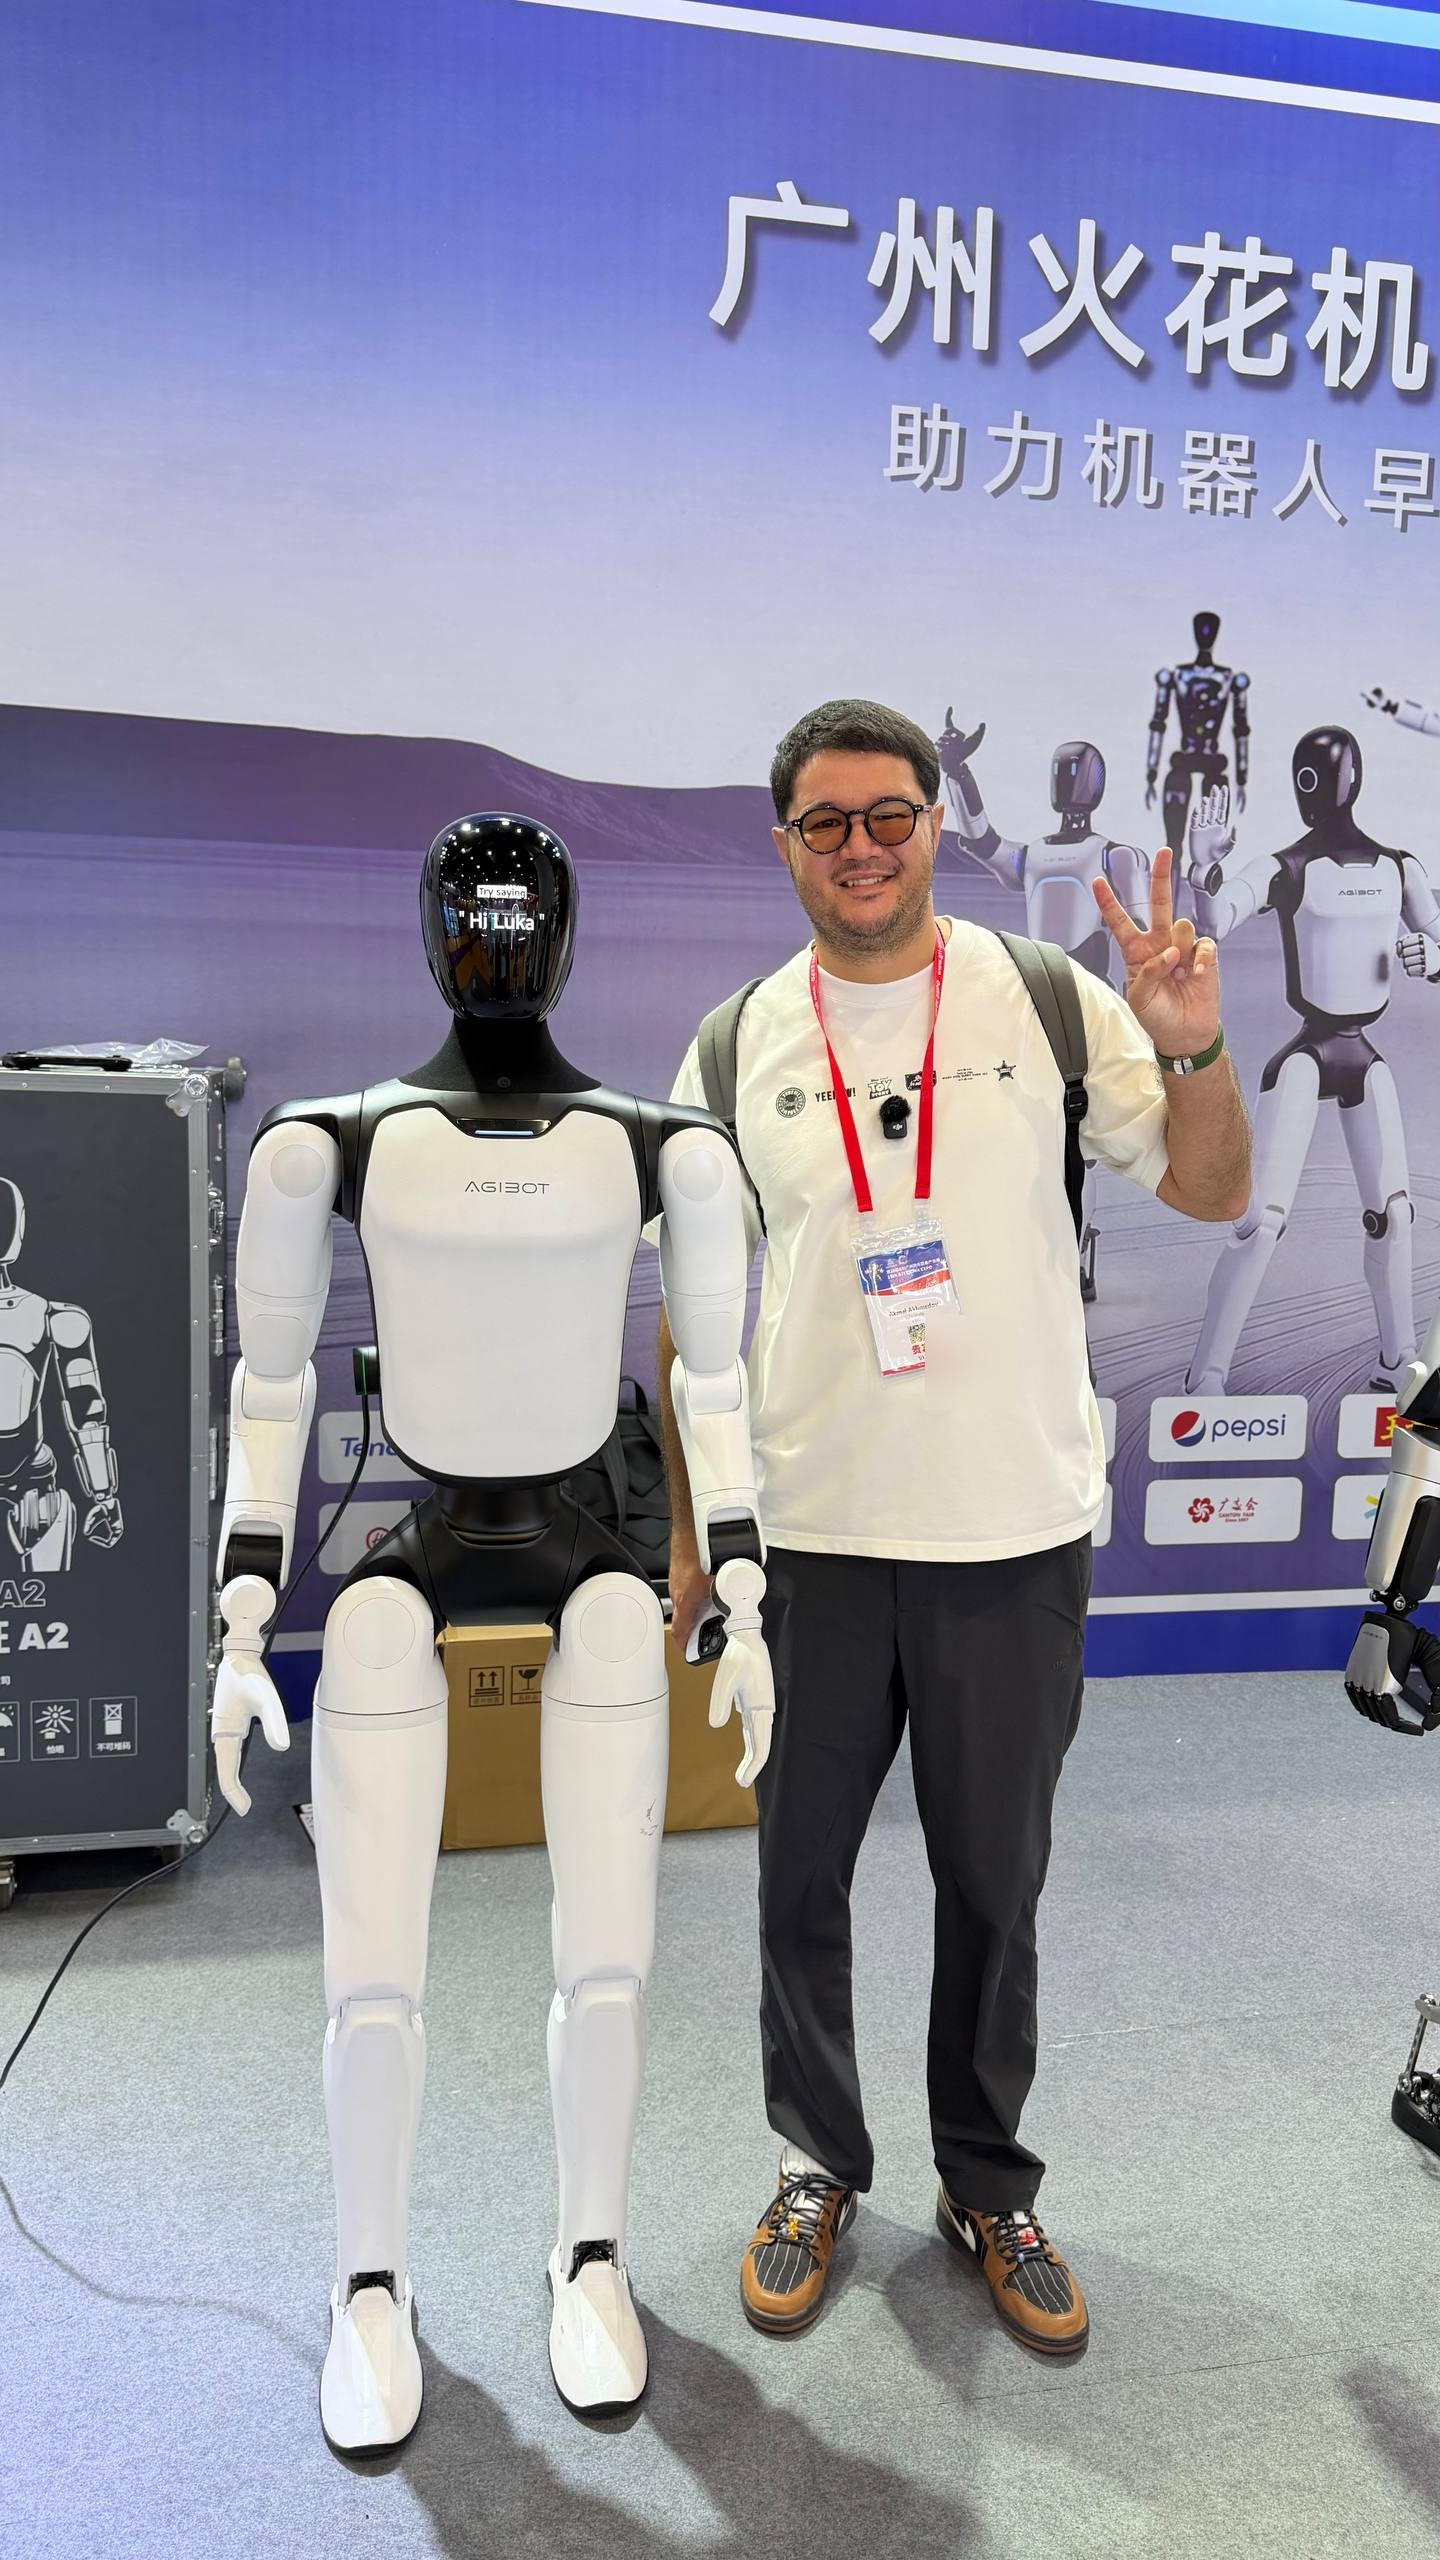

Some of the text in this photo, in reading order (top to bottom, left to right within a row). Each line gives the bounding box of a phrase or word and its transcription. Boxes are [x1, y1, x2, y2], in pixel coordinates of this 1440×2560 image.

[708, 180, 1429, 391] 广州火花机
[883, 403, 1438, 530] 助力机器人早
[479, 887, 526, 898] Try saying
[815, 1087, 857, 1103] YEEW!
[464, 1180, 550, 1195] AGIBOT
[1212, 1414, 1286, 1442] pepsi
[0, 1578, 46, 1609] A2
[18, 1621, 69, 1651] A2
